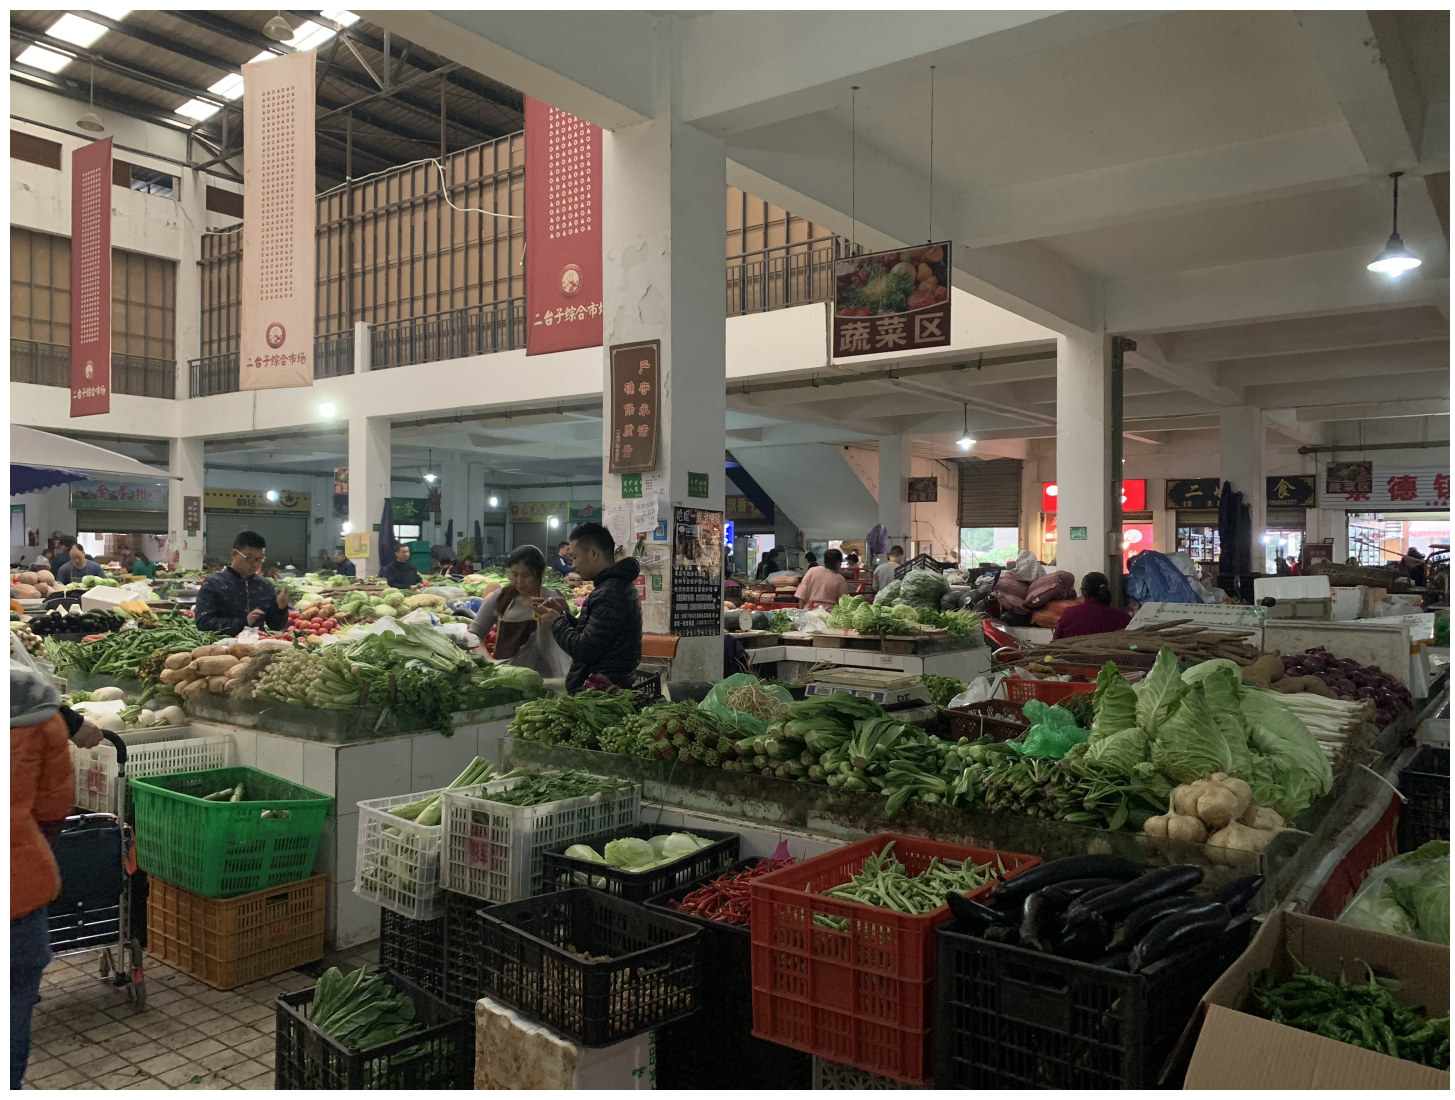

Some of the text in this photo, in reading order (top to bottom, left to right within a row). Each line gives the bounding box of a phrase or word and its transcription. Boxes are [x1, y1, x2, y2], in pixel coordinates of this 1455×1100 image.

[839, 311, 946, 352] 蔬菜区
[246, 352, 306, 368] 二台子综合市场
[637, 359, 651, 438] 严守承诺
[1273, 478, 1296, 498] 食
[401, 500, 419, 517] 茶
